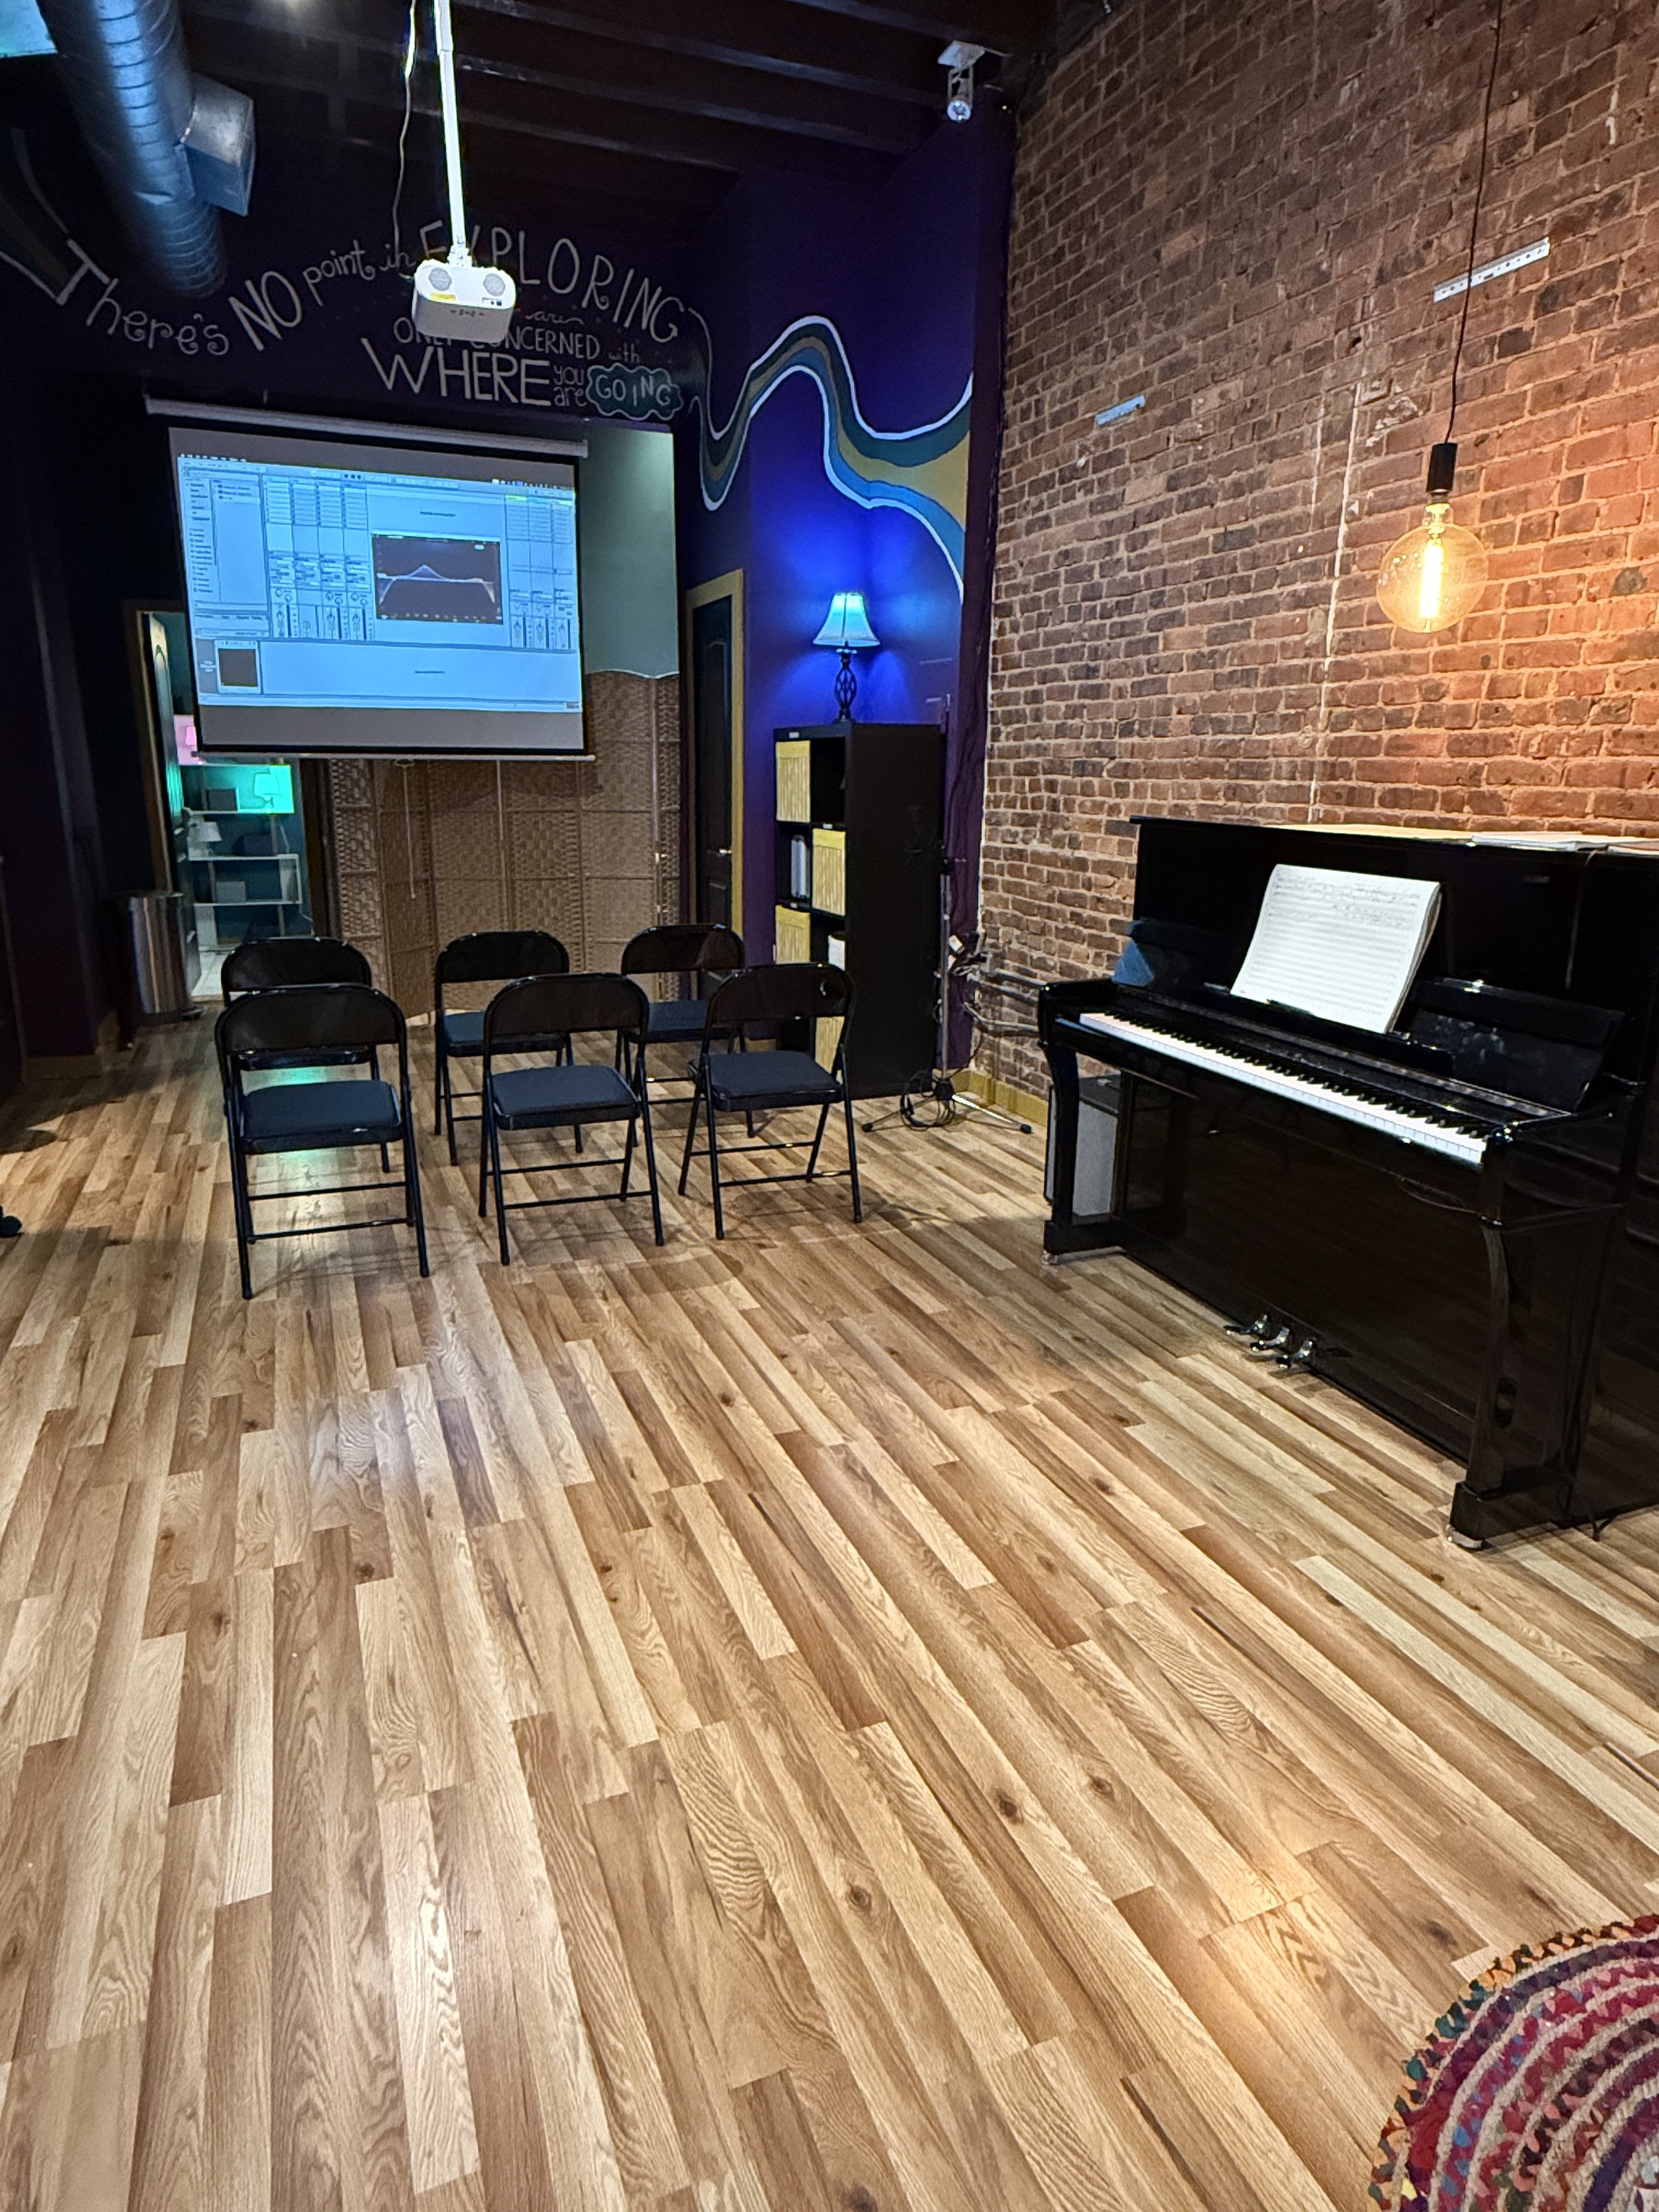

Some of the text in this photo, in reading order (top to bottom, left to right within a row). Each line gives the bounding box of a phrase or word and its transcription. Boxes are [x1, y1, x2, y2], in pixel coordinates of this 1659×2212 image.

[56, 238, 230, 356] There's
[228, 270, 303, 351] NO
[301, 239, 378, 307] point
[378, 243, 418, 271] in
[360, 337, 672, 407] WHERE you are GOING
[470, 325, 601, 360] NCERNED
[608, 342, 640, 364] with
